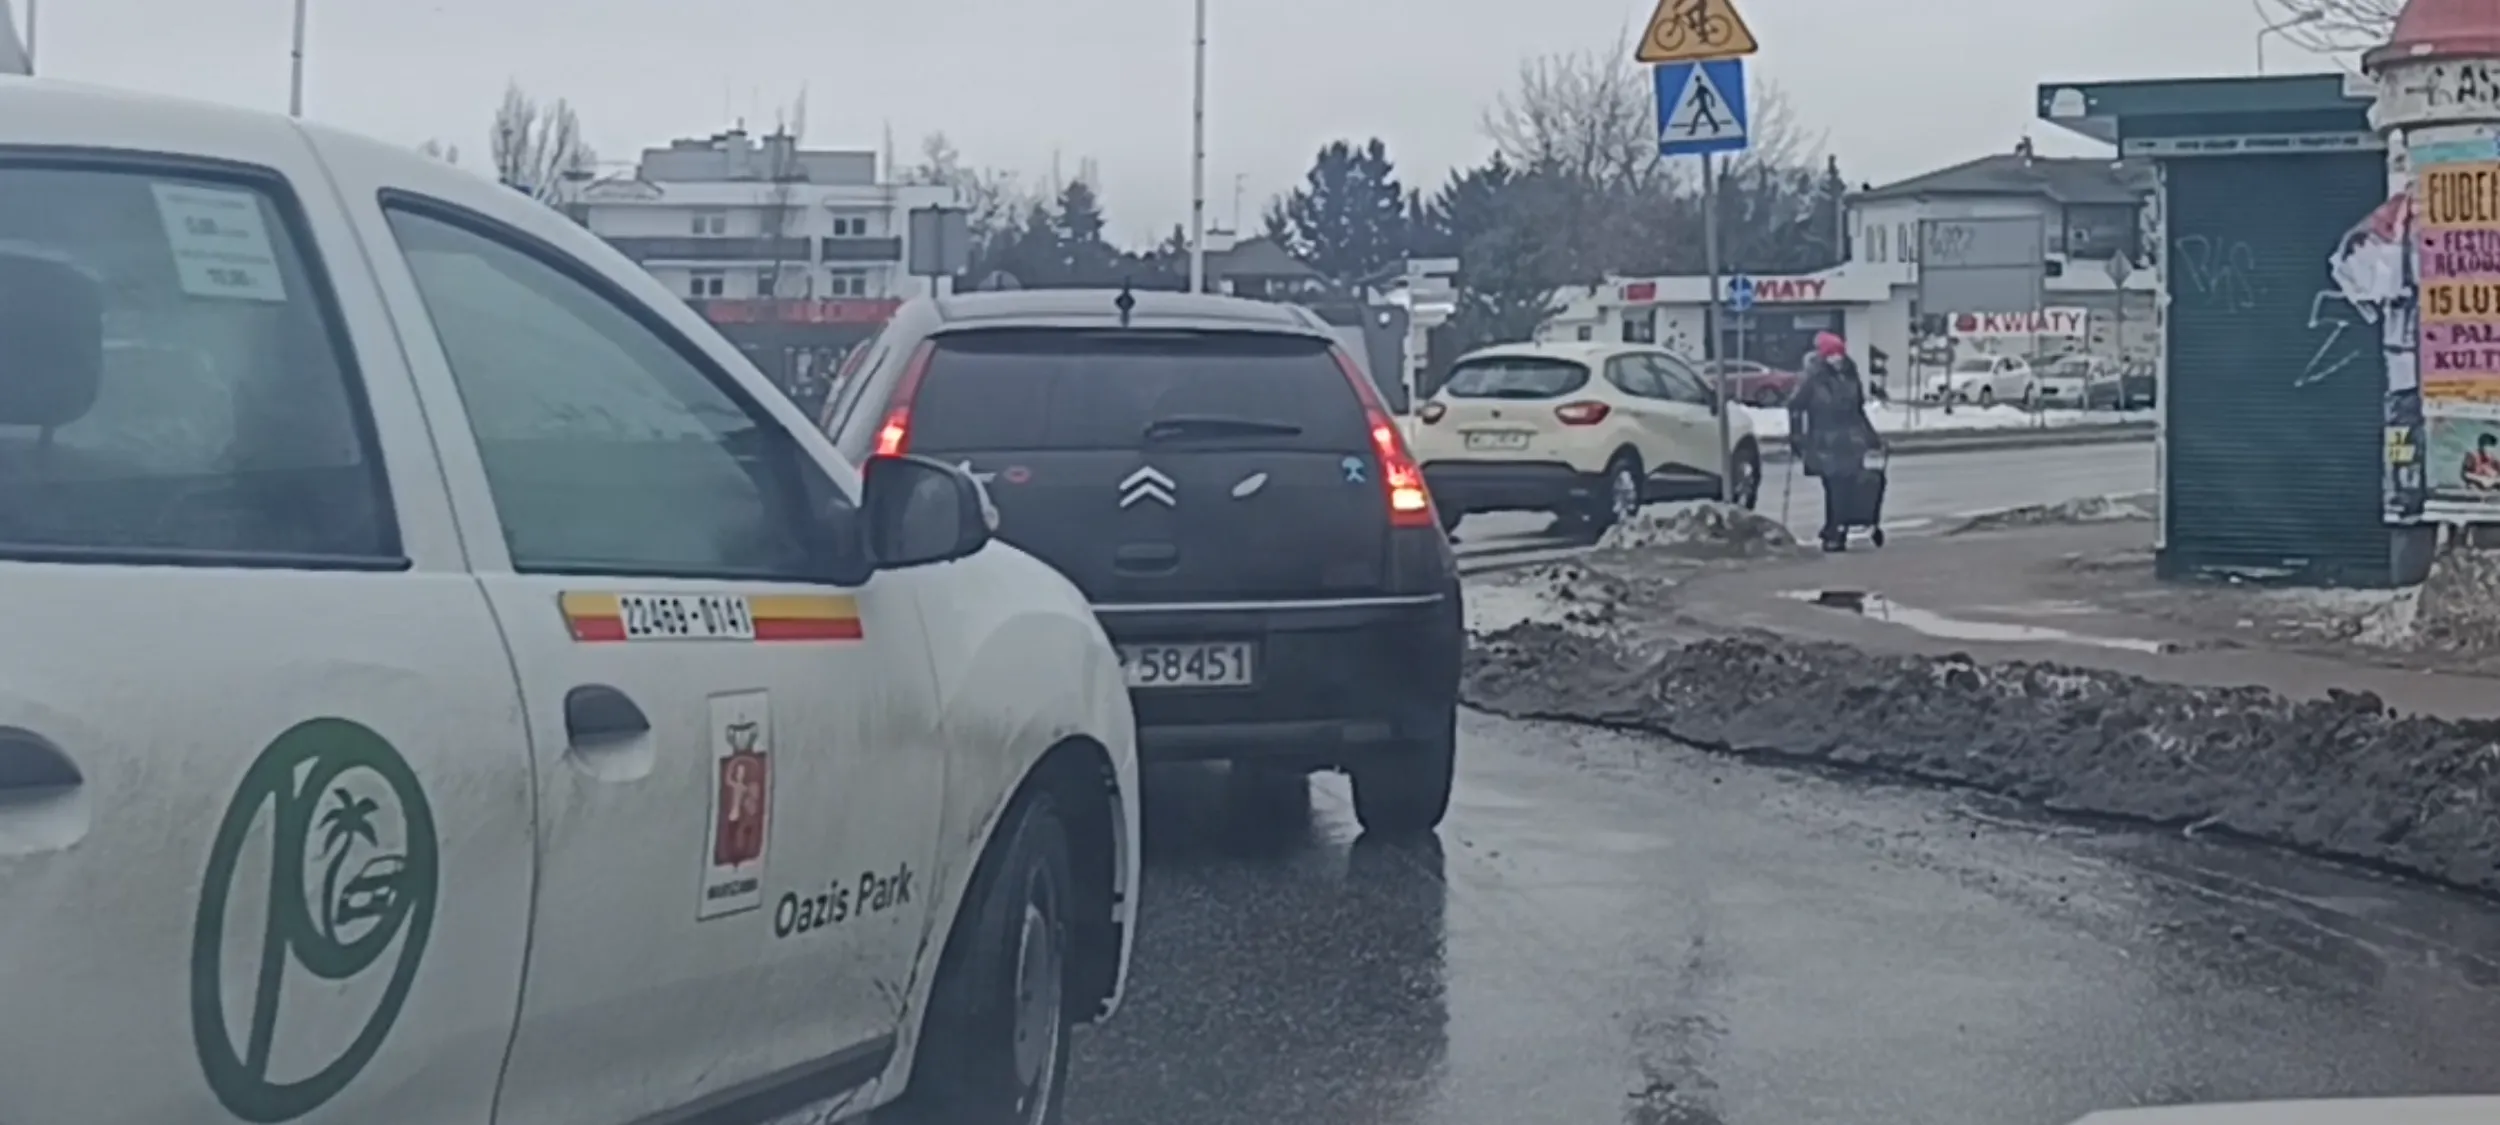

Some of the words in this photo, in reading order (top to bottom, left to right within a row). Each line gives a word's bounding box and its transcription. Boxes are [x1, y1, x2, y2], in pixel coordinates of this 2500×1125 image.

[1752, 279, 1826, 299] WIATY
[2428, 285, 2453, 315] 15
[1983, 311, 2081, 334] KWIATY
[2435, 349, 2500, 370] KULT
[1139, 646, 1244, 682] 58451
[773, 879, 849, 938] Oazis
[855, 861, 913, 917] Park
